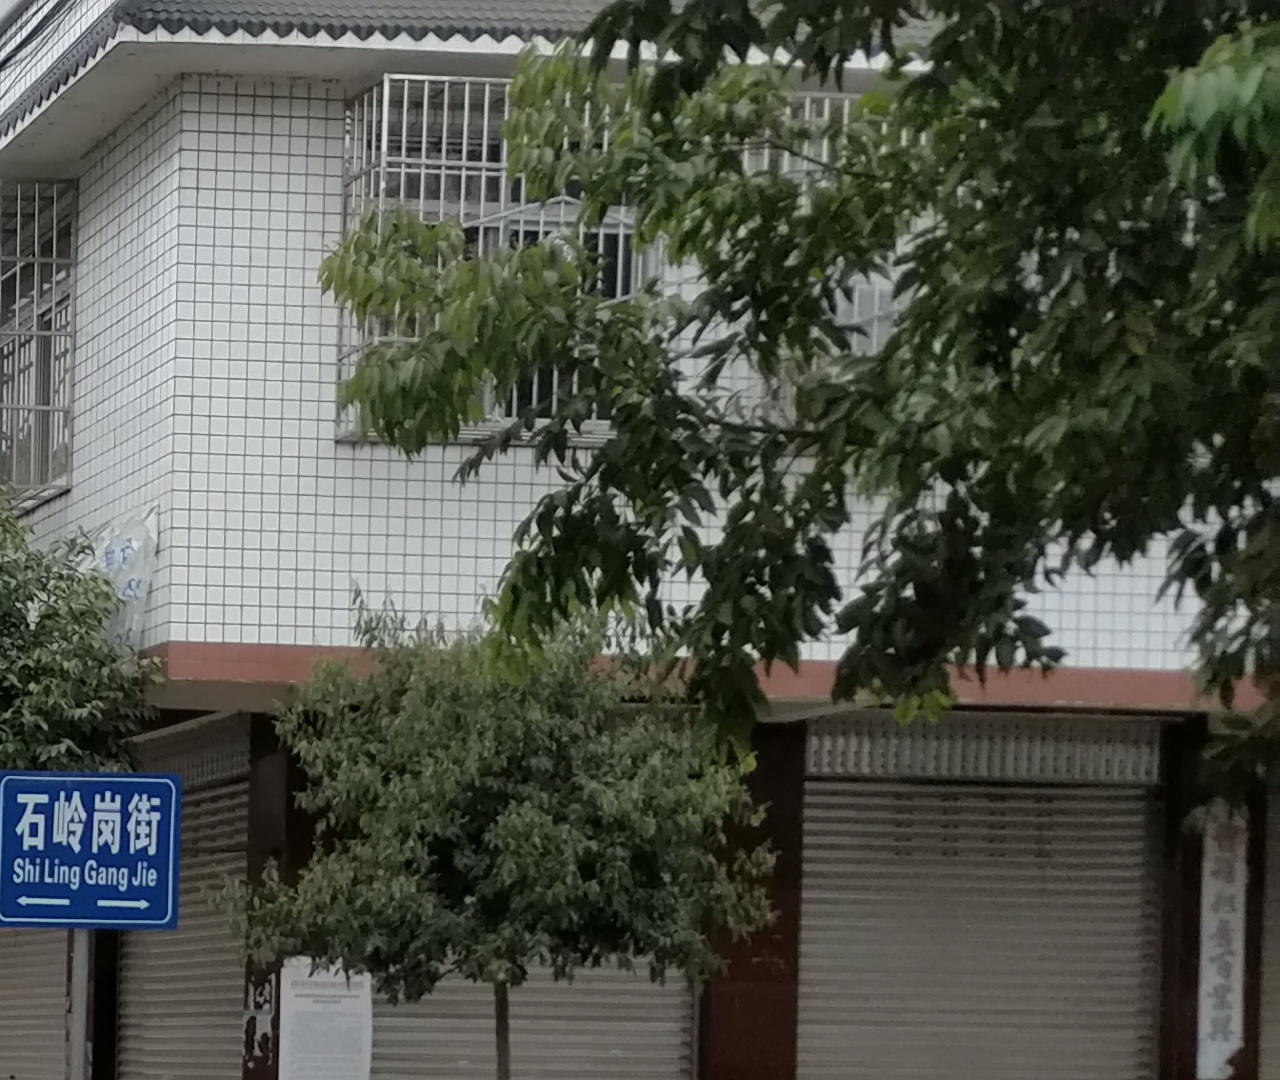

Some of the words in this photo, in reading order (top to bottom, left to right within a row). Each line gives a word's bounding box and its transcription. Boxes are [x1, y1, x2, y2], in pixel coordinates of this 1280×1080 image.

[15, 790, 162, 856] 石岭岗街
[12, 857, 41, 884] Shi
[44, 858, 80, 891] Ling
[84, 859, 129, 892] Gang
[132, 861, 158, 887] Jie
